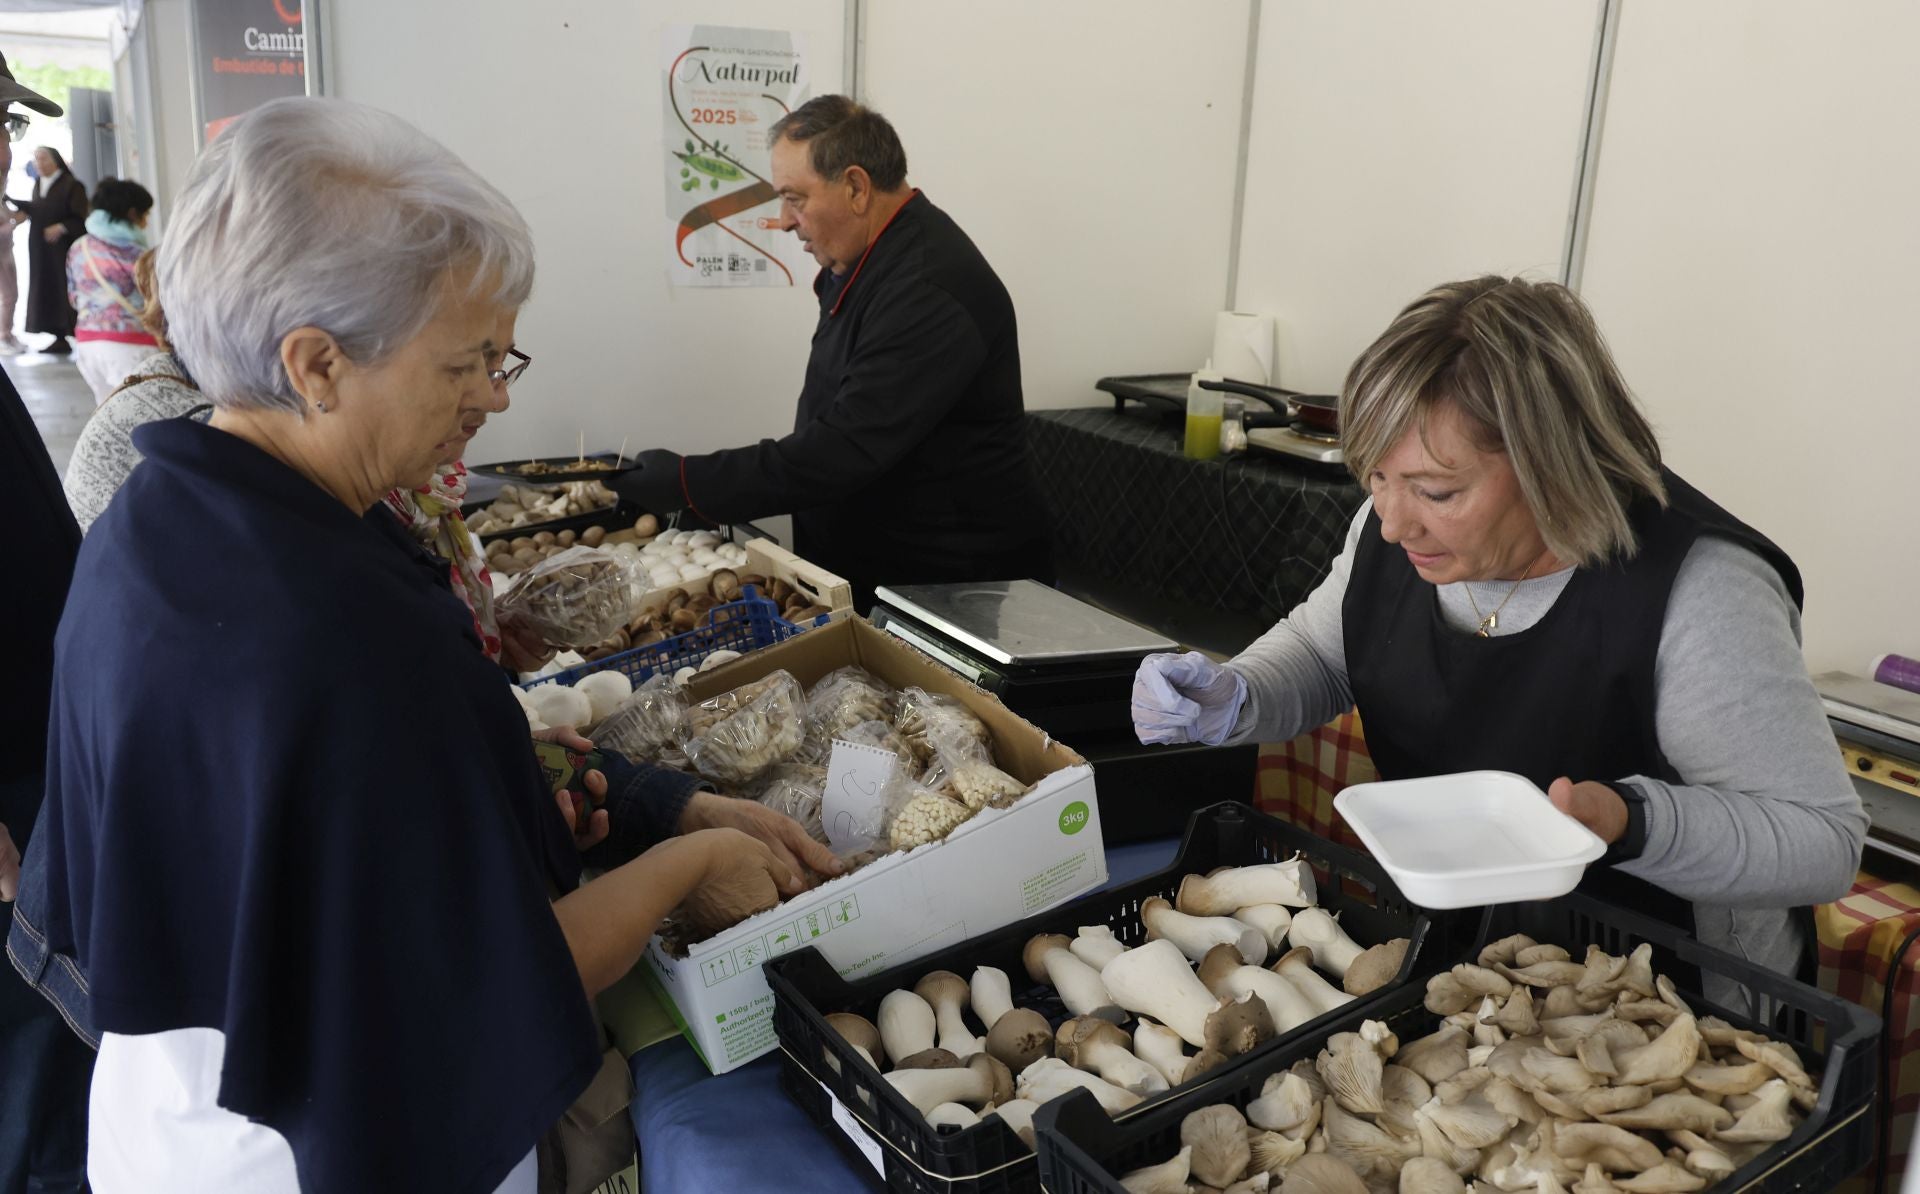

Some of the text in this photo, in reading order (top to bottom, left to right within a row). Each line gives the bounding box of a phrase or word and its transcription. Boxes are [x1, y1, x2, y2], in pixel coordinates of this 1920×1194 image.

[679, 57, 800, 86] Naturpal
[691, 107, 737, 125] 2025
[1063, 810, 1085, 826] 3kg
[729, 1003, 748, 1017] 150g
[754, 994, 770, 1007] bag
[720, 1009, 765, 1034] Authorized
